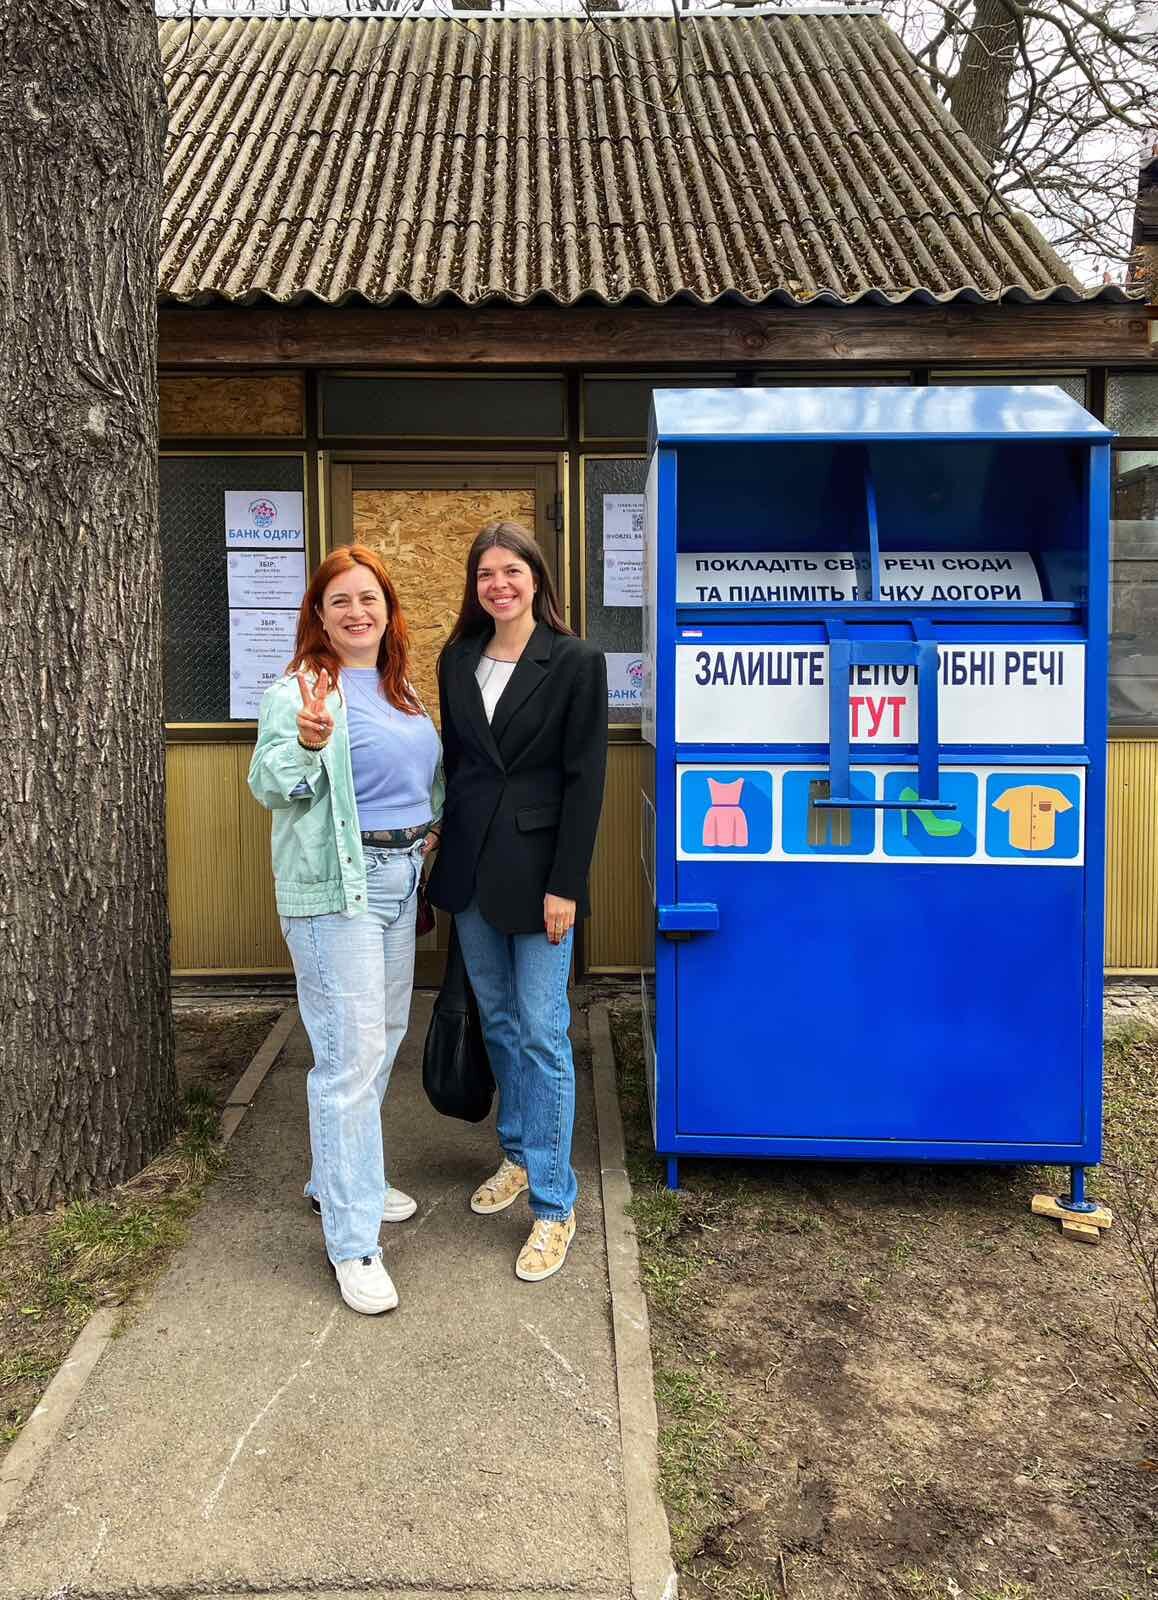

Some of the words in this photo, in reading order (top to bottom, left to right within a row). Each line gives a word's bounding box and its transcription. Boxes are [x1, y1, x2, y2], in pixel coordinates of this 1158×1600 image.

[229, 529, 260, 540] БАНК
[263, 529, 301, 541] ОДЯГУ
[695, 558, 818, 573] ПОКЛАДІТЬ
[884, 559, 936, 572] РЕЧІ
[941, 558, 1013, 572] СЮДИ
[695, 586, 723, 602] ТА
[728, 585, 845, 602] ПІДНІМІТЬ
[930, 584, 1022, 602] ДОГОРИ
[695, 651, 825, 686] ЗАЛИШТЕ
[1005, 651, 1064, 686] РЕЧІ
[607, 688, 637, 699] БАНК
[848, 696, 907, 737] ТУТ
